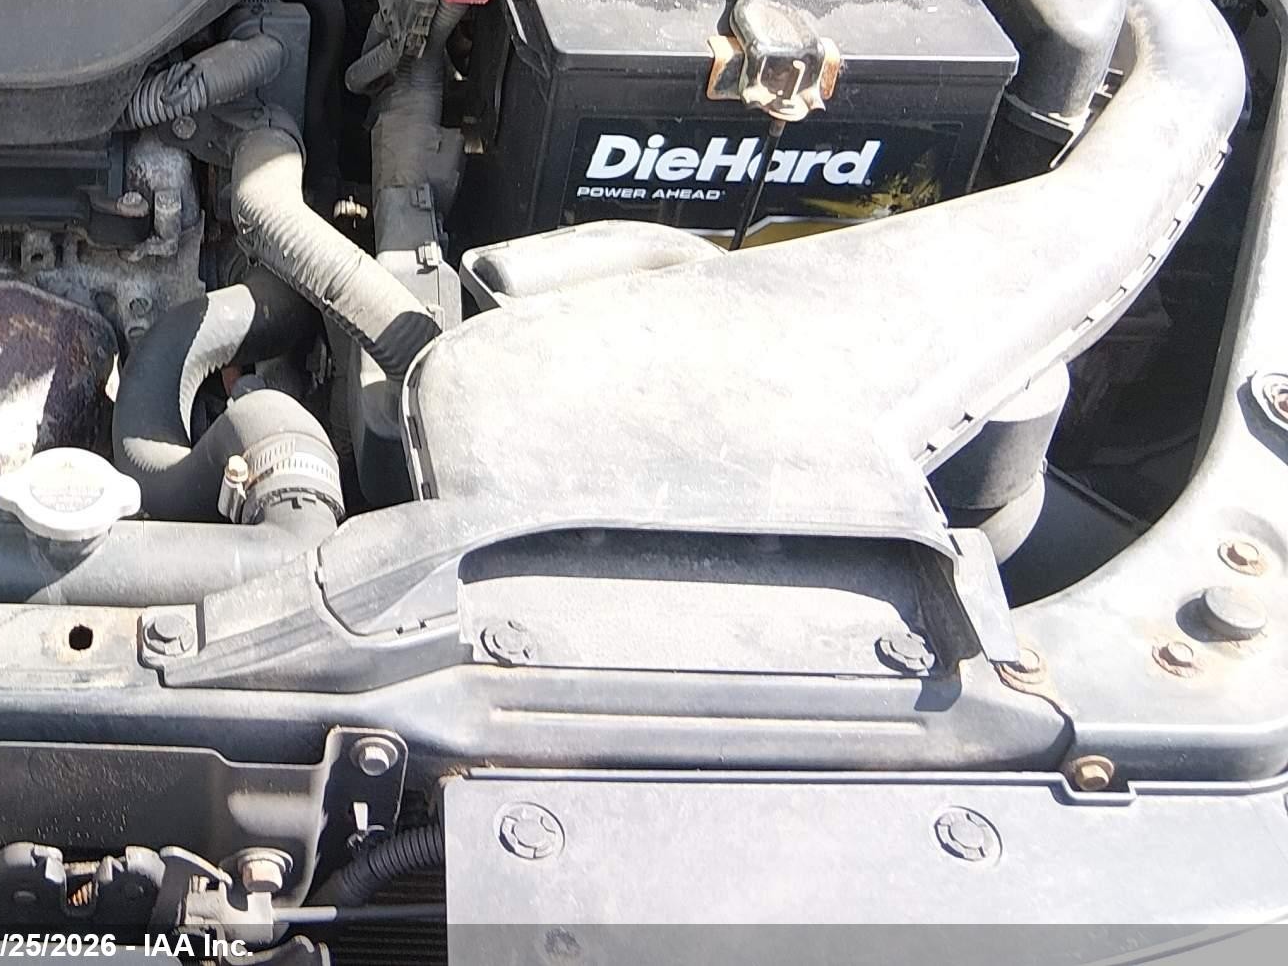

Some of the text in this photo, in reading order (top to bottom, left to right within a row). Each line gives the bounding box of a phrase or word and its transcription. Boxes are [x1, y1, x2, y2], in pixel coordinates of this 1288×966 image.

[585, 134, 881, 185] DieHard
[577, 185, 722, 201] POWER AHEAD
